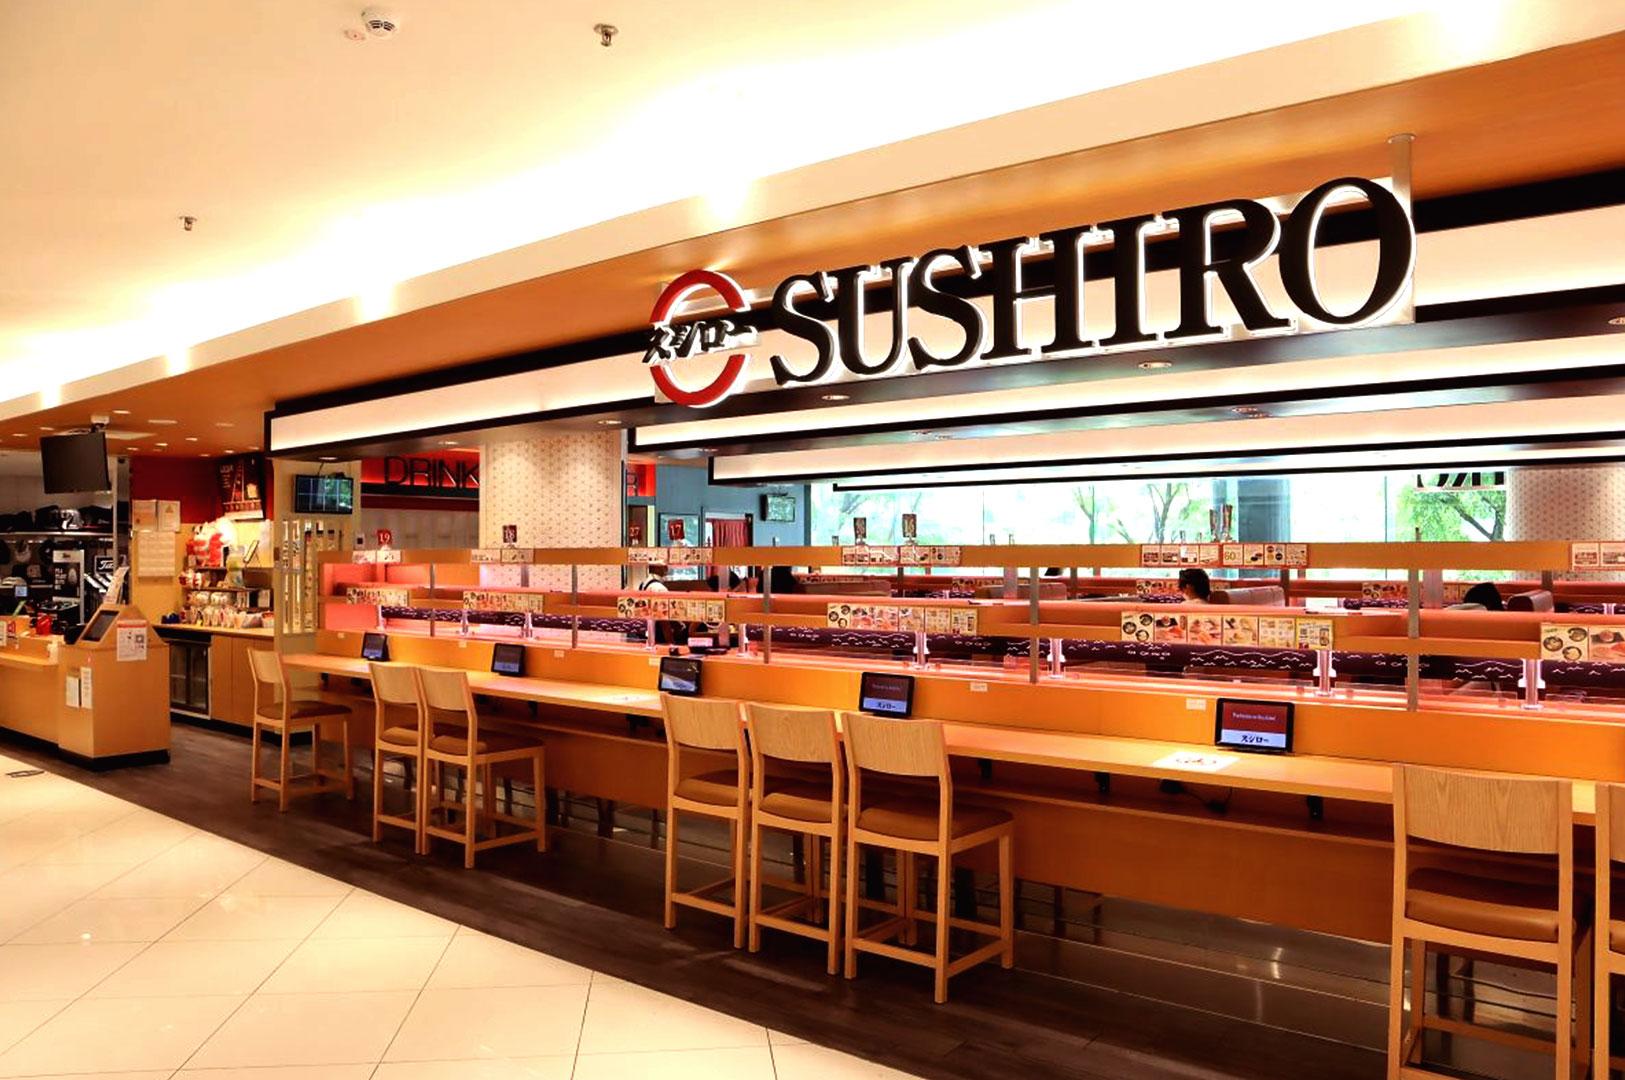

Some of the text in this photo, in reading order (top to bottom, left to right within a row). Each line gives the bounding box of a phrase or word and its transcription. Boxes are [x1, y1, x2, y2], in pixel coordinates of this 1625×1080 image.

[770, 176, 1415, 387] SUSHIRO
[384, 456, 480, 488] DRINK
[380, 532, 390, 543] 19
[670, 523, 682, 537] 17
